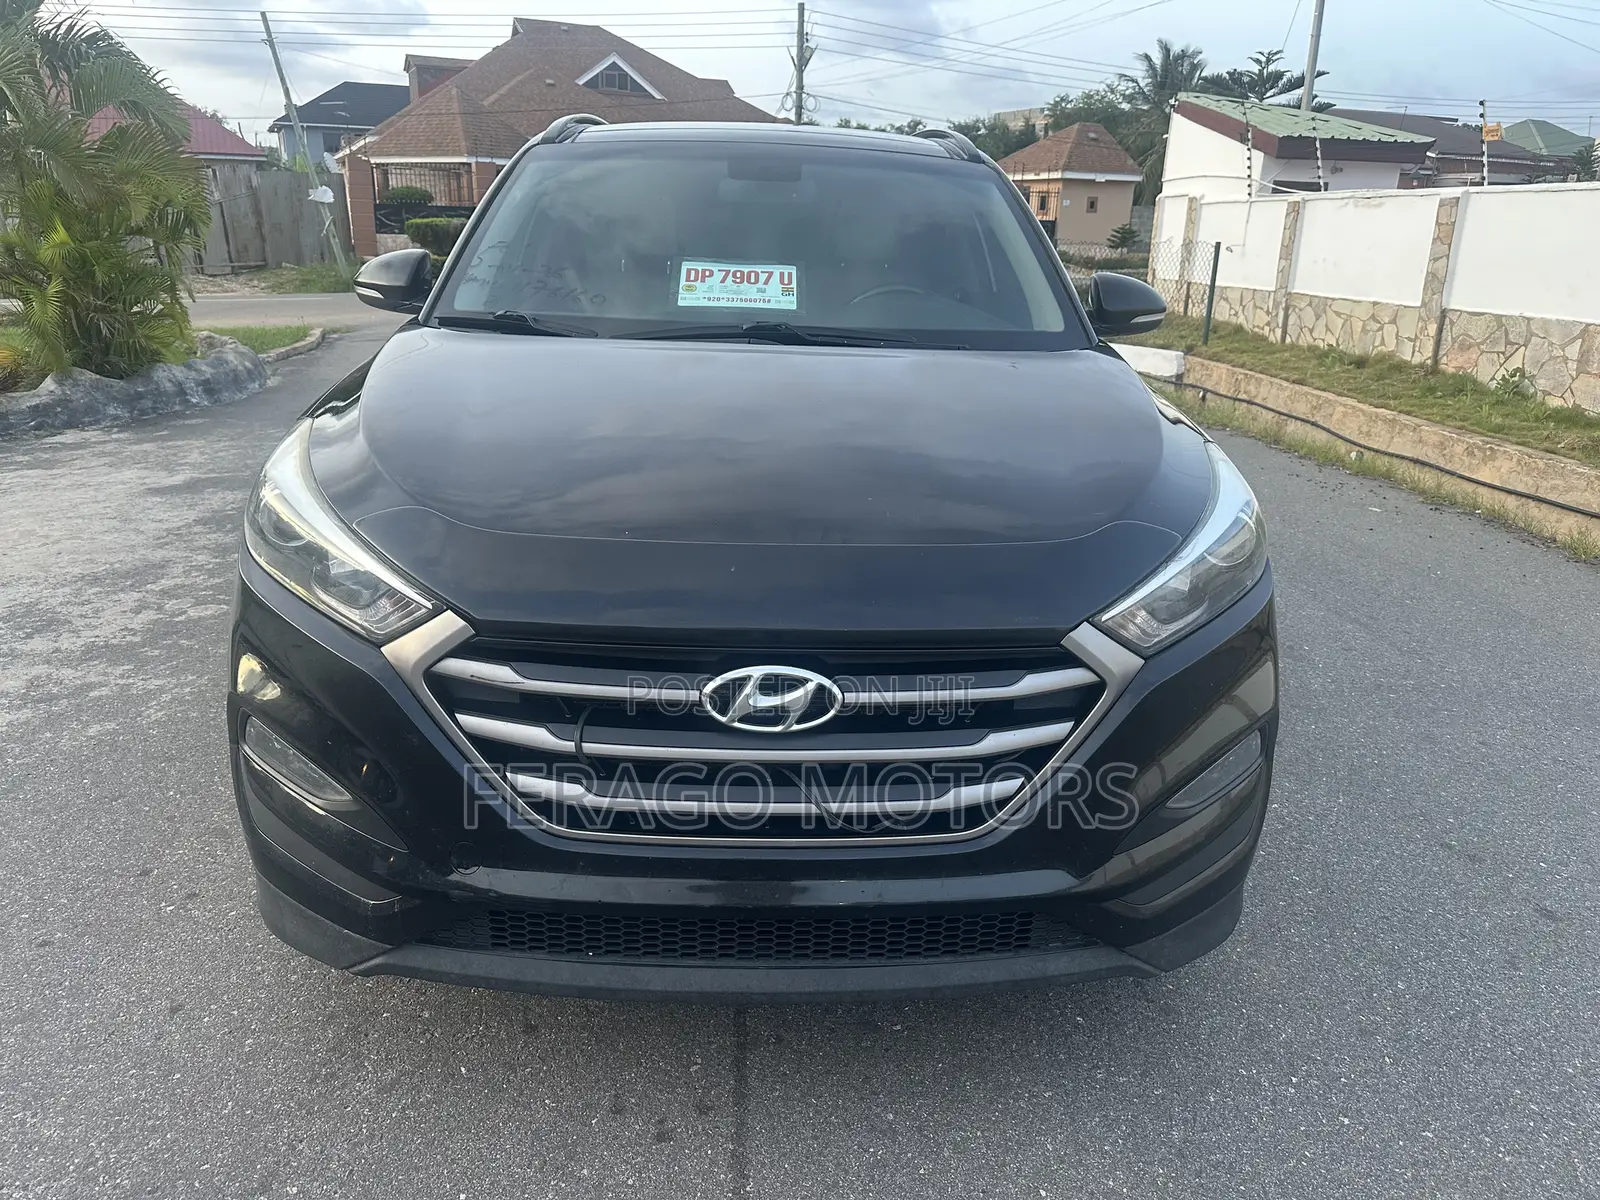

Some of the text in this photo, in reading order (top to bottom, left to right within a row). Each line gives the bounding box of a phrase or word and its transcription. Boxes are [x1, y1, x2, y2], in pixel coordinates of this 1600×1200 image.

[685, 267, 793, 286] DP 7907 U
